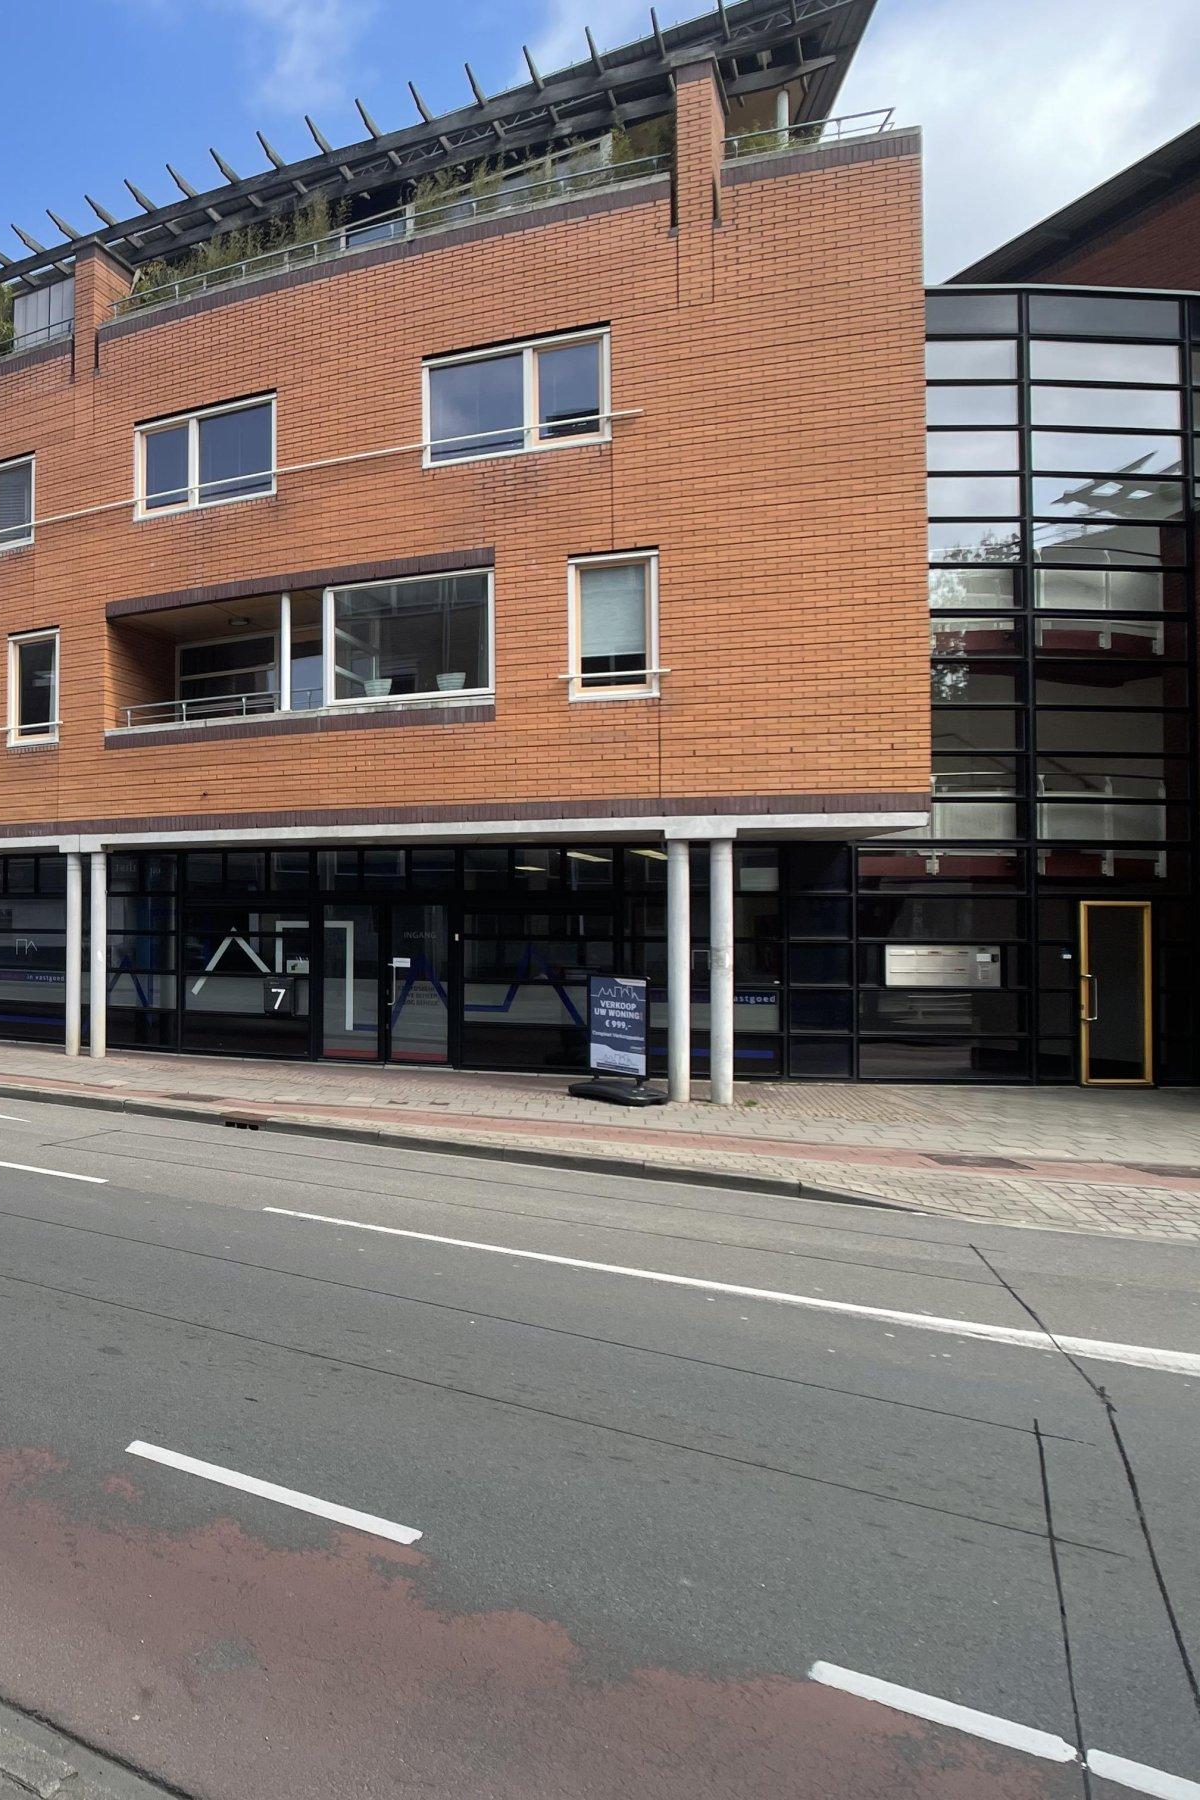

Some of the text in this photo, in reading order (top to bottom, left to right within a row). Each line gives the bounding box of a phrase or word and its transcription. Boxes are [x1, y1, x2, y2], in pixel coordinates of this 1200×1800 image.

[35, 974, 65, 982] vastgoed
[271, 988, 286, 1010] 7
[733, 995, 776, 1004] astgoed
[600, 1000, 637, 1011] VERKOOP
[594, 1008, 607, 1016] UW
